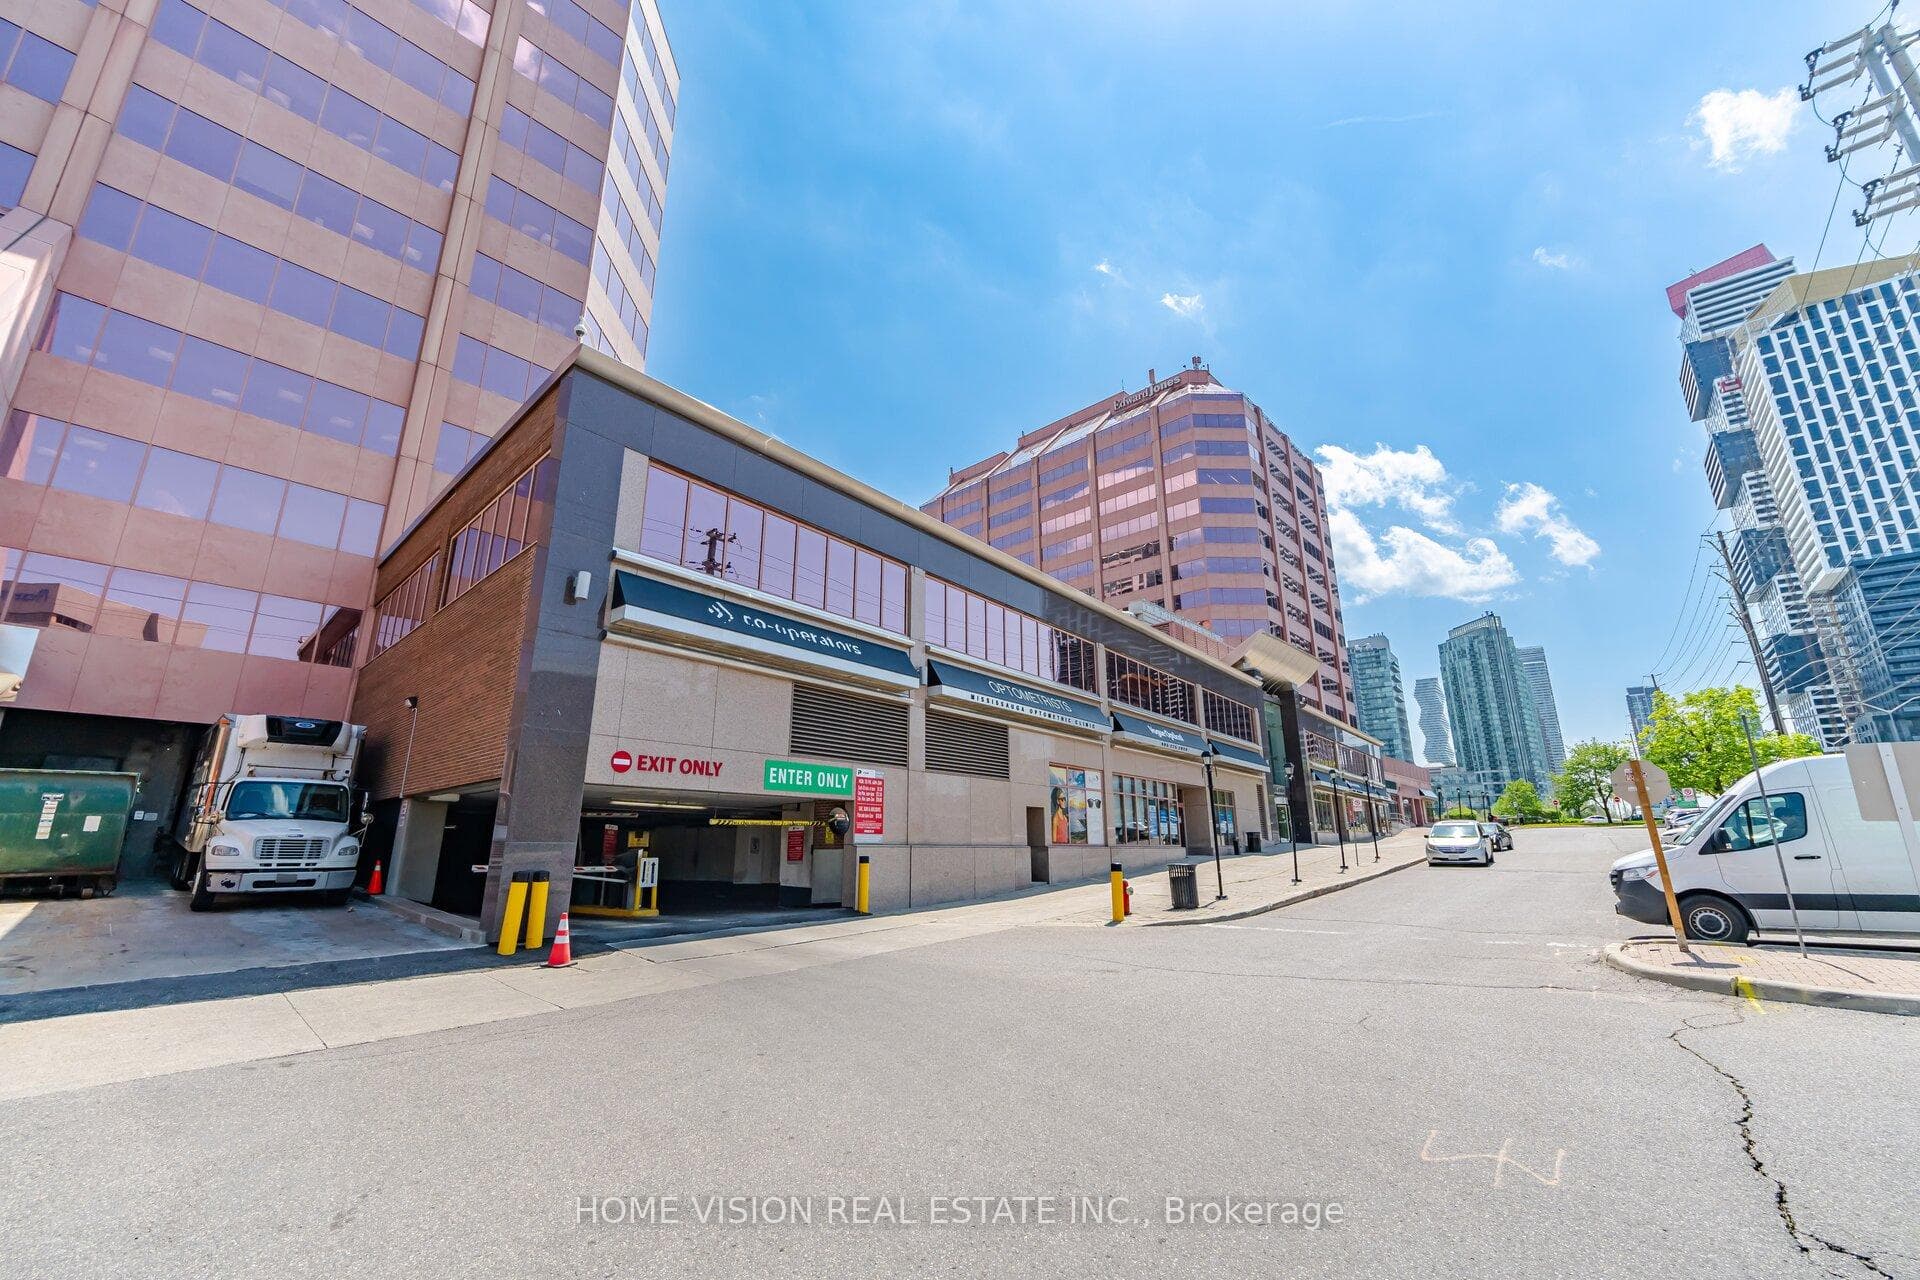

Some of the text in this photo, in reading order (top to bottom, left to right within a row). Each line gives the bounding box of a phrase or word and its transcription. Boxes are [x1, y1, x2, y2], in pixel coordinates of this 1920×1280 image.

[1113, 376, 1181, 411] Edward Jones
[970, 693, 1096, 730] MISSISSAUGA OPTOMETRIC CLINIC
[988, 680, 1073, 713] OPTOMETRISTS
[637, 754, 723, 777] EXIT ONLY
[769, 767, 849, 789] ENTER ONLY
